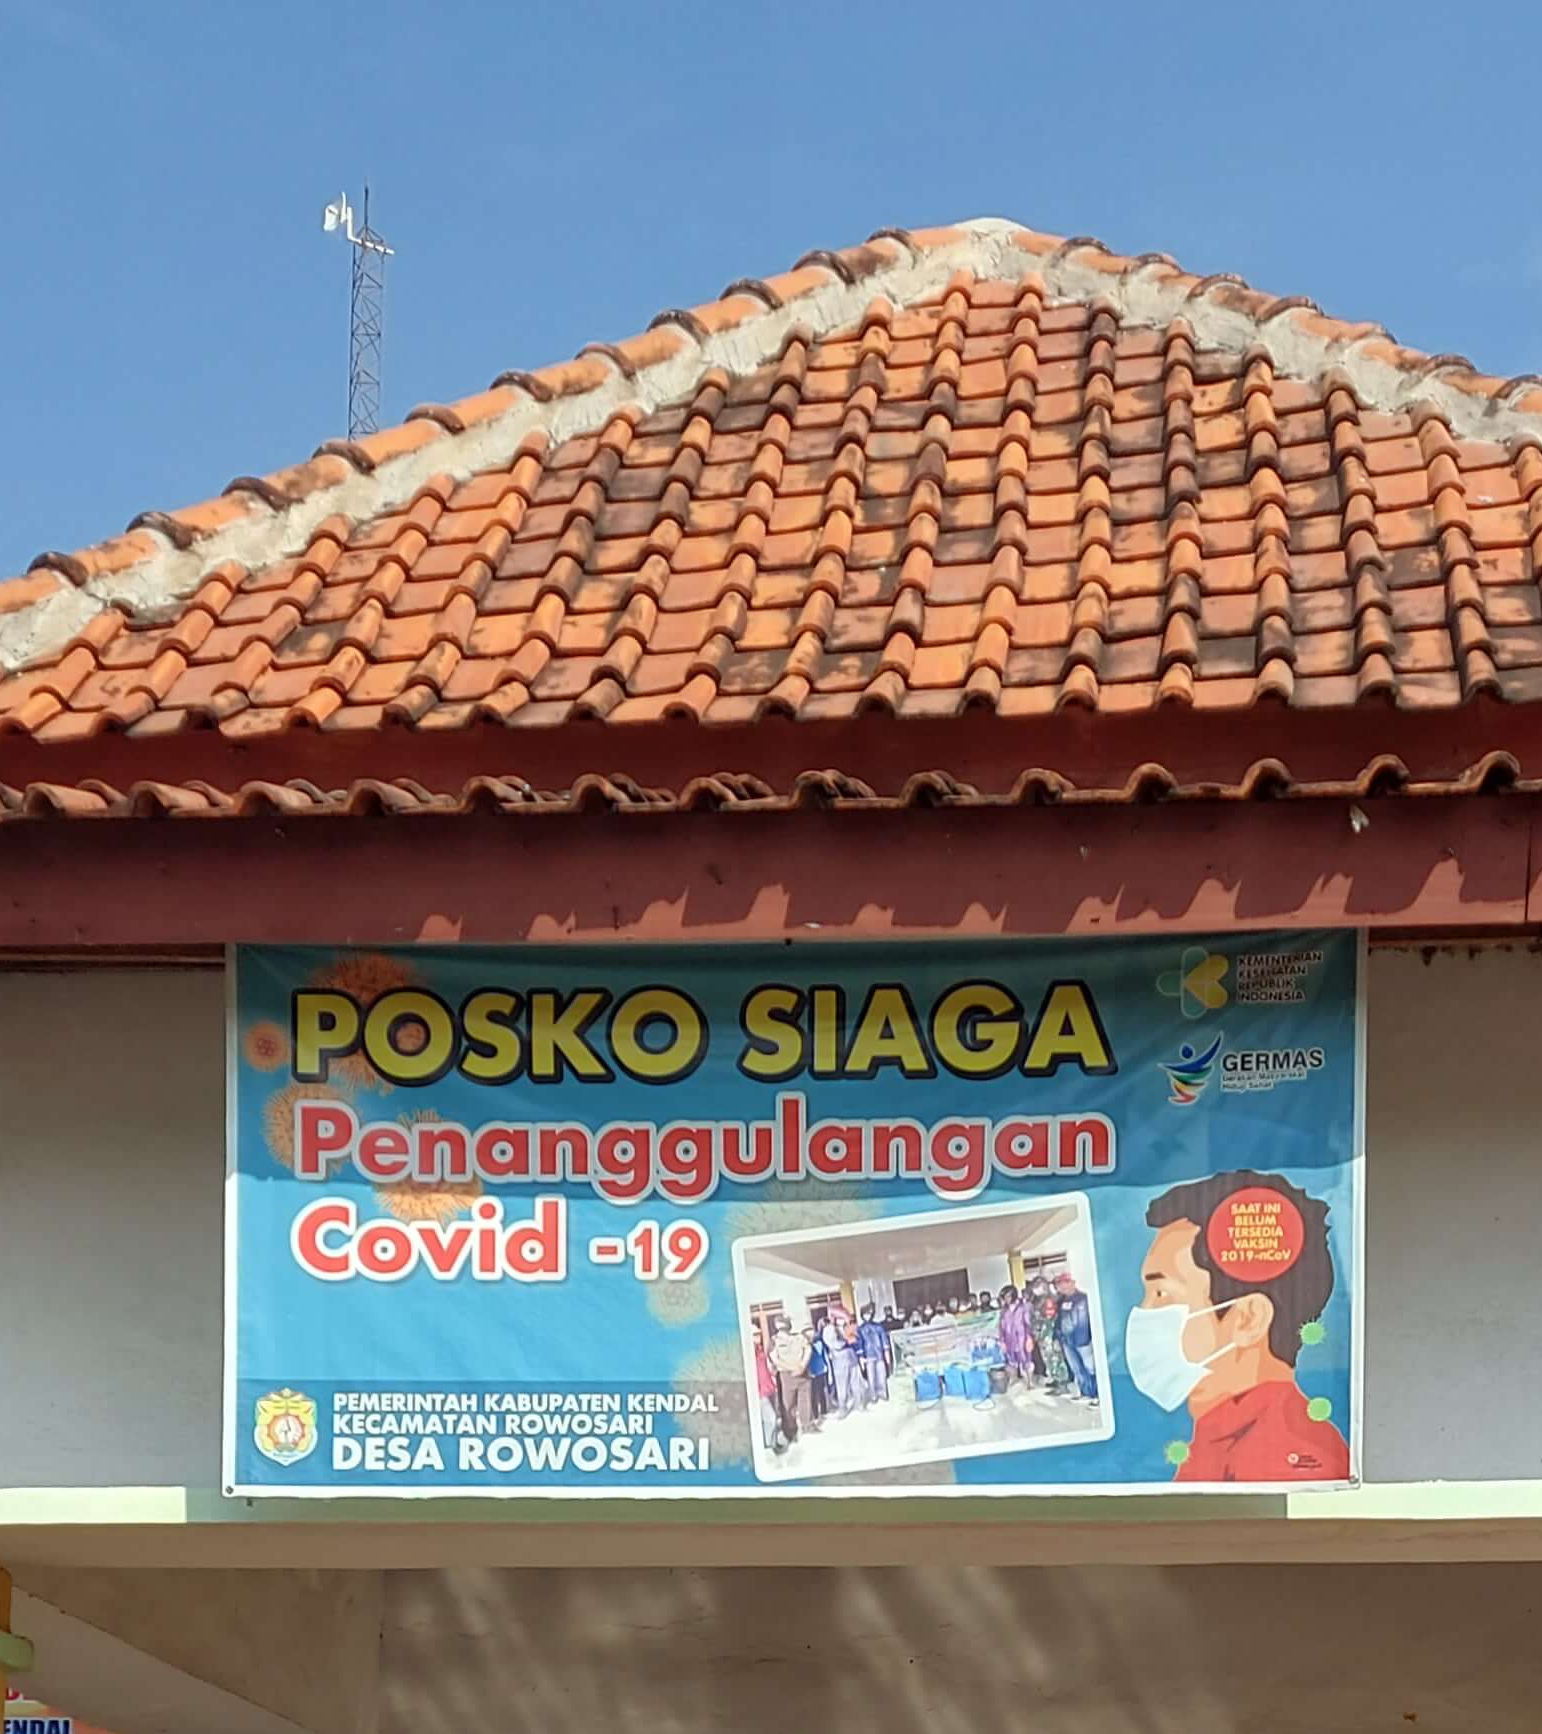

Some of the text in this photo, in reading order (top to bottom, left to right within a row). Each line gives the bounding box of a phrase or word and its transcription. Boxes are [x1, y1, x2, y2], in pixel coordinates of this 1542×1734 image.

[293, 979, 1117, 1086] POSKO SIAGA
[1222, 1049, 1323, 1072] GERMAS
[295, 1092, 1116, 1205] Penanggulangan
[1231, 1202, 1281, 1215] SAAT INI
[1234, 1215, 1276, 1226] BELUM
[292, 1196, 708, 1281] Covid -19
[1227, 1226, 1284, 1238] TERSEDIA
[1233, 1238, 1279, 1249] VAKSIN
[1220, 1249, 1291, 1262] 2019-nCoV
[333, 1393, 719, 1413] PEMERINTAH KABUPATEN KENDAL
[333, 1413, 653, 1435] KECAMATAN ROWOSARI
[332, 1437, 711, 1472] DESA ROWOSARI
